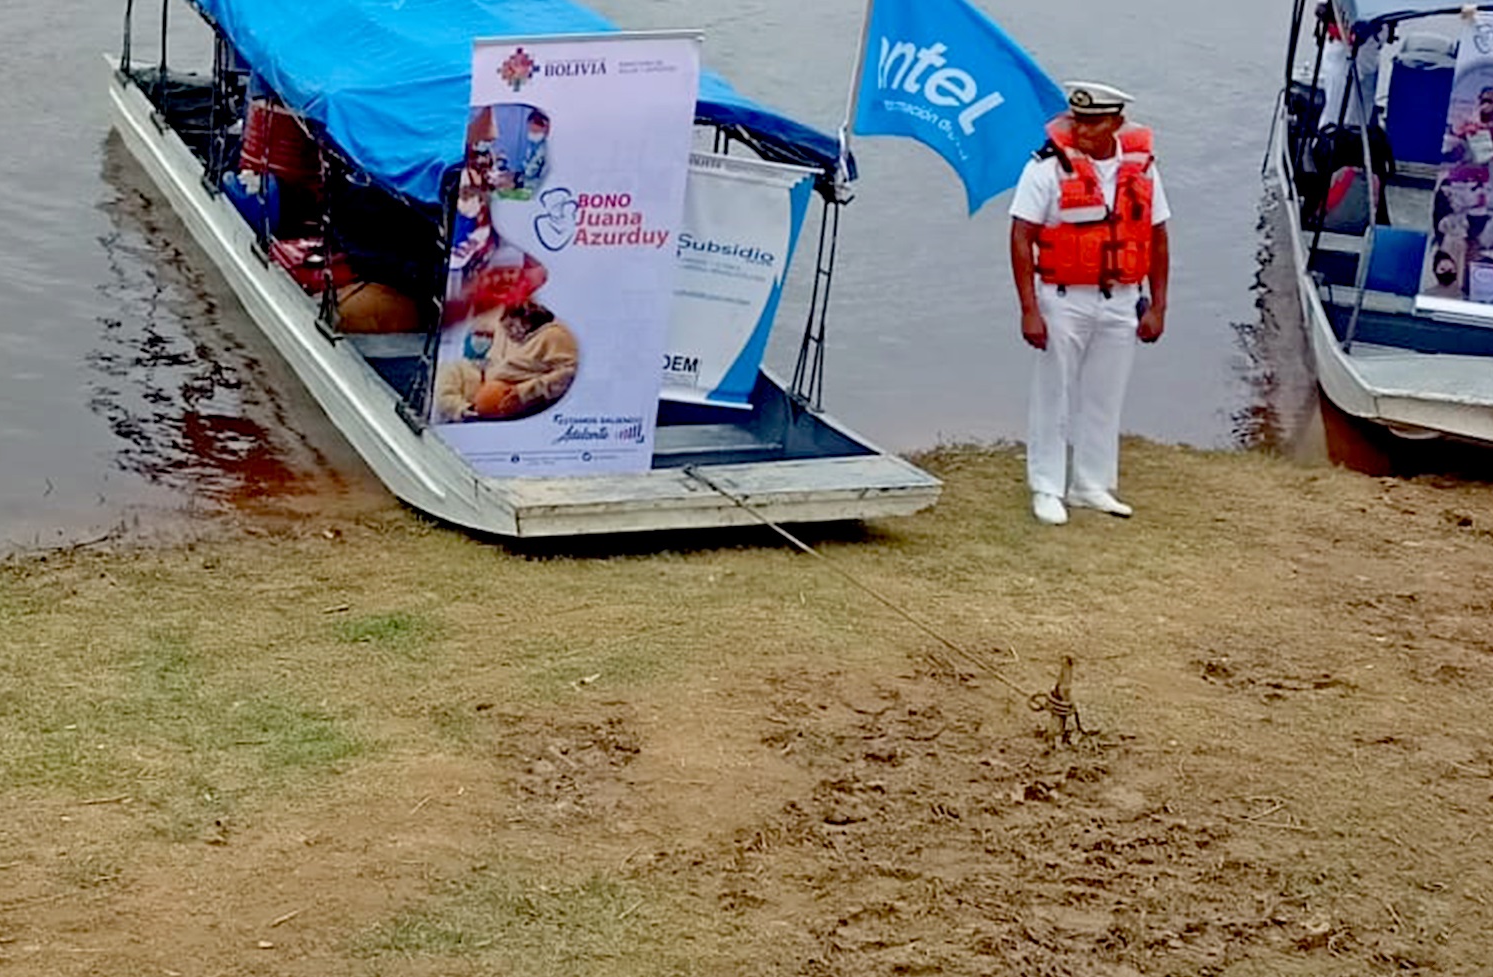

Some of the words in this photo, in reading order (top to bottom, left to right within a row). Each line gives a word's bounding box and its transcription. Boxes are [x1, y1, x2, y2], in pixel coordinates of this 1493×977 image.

[578, 193, 632, 209] BONO
[575, 209, 643, 226] Juana
[573, 226, 670, 250] Azurduy
[678, 232, 776, 264] Subsidio
